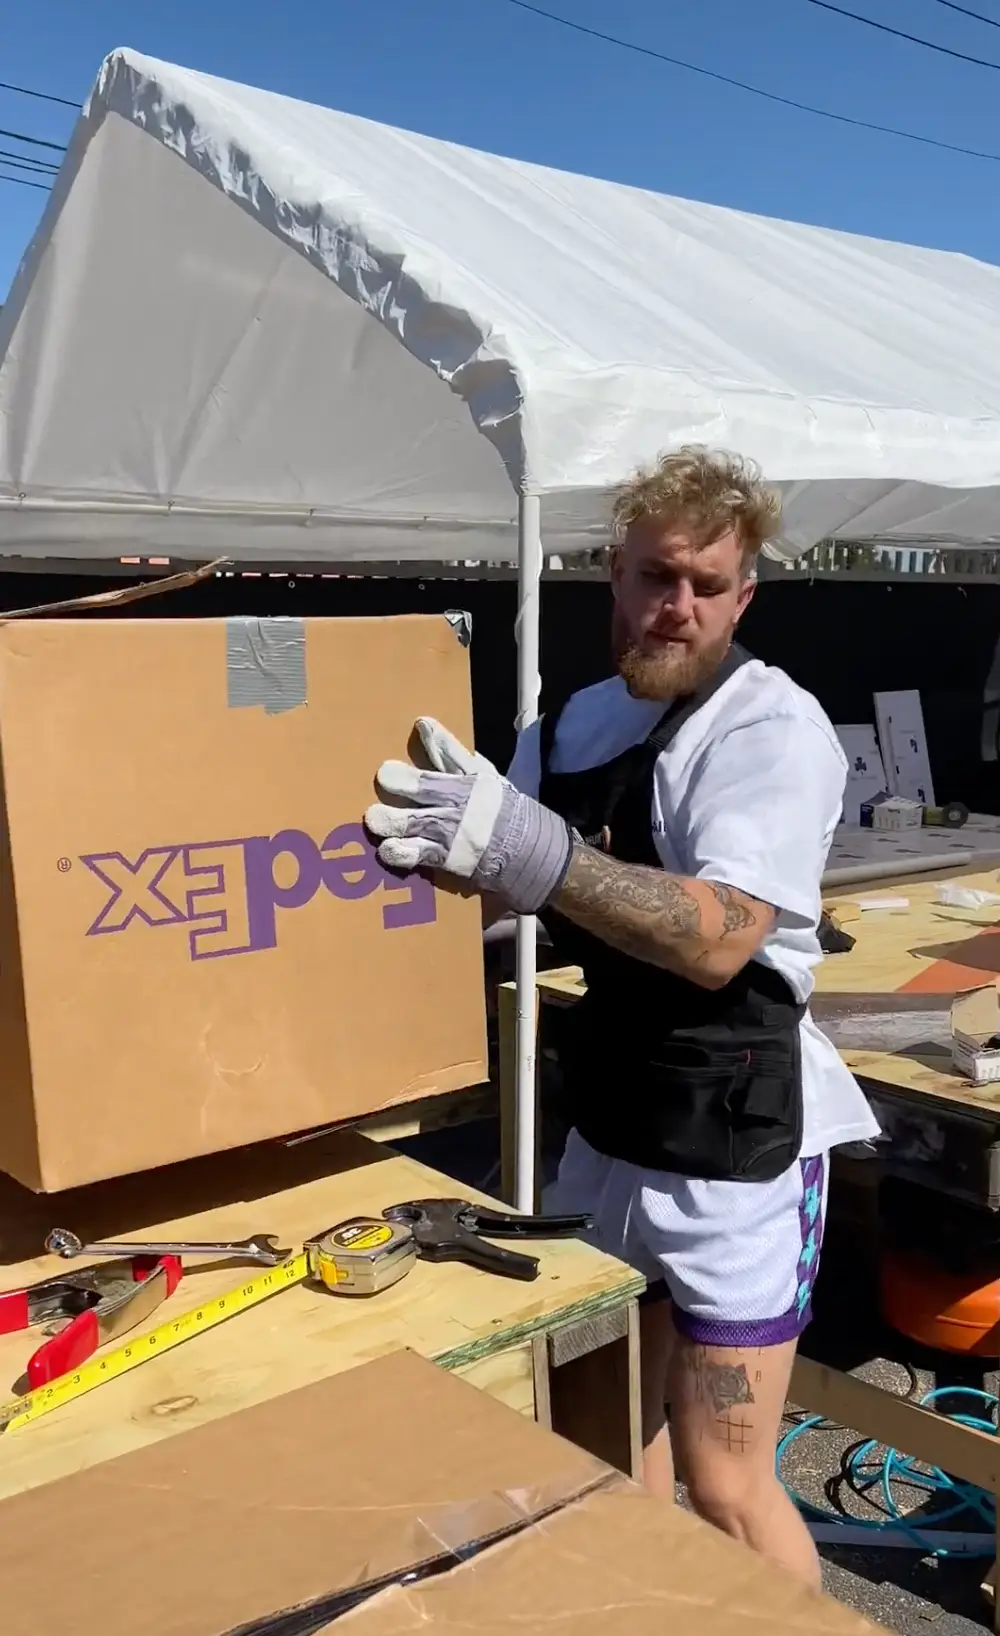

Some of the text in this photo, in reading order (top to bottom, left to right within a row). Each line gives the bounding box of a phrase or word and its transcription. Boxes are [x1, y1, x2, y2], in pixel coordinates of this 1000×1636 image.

[46, 1388, 54, 1398] 2
[73, 1375, 81, 1384] 3
[100, 1361, 107, 1370] 4
[125, 1348, 132, 1357] 5
[149, 1335, 157, 1344] 6
[172, 1323, 180, 1332] 7
[196, 1311, 203, 1320] 8
[218, 1300, 225, 1308] 9
[242, 1286, 254, 1296] 10
[263, 1276, 273, 1285] 11
[285, 1269, 295, 1279] 12
